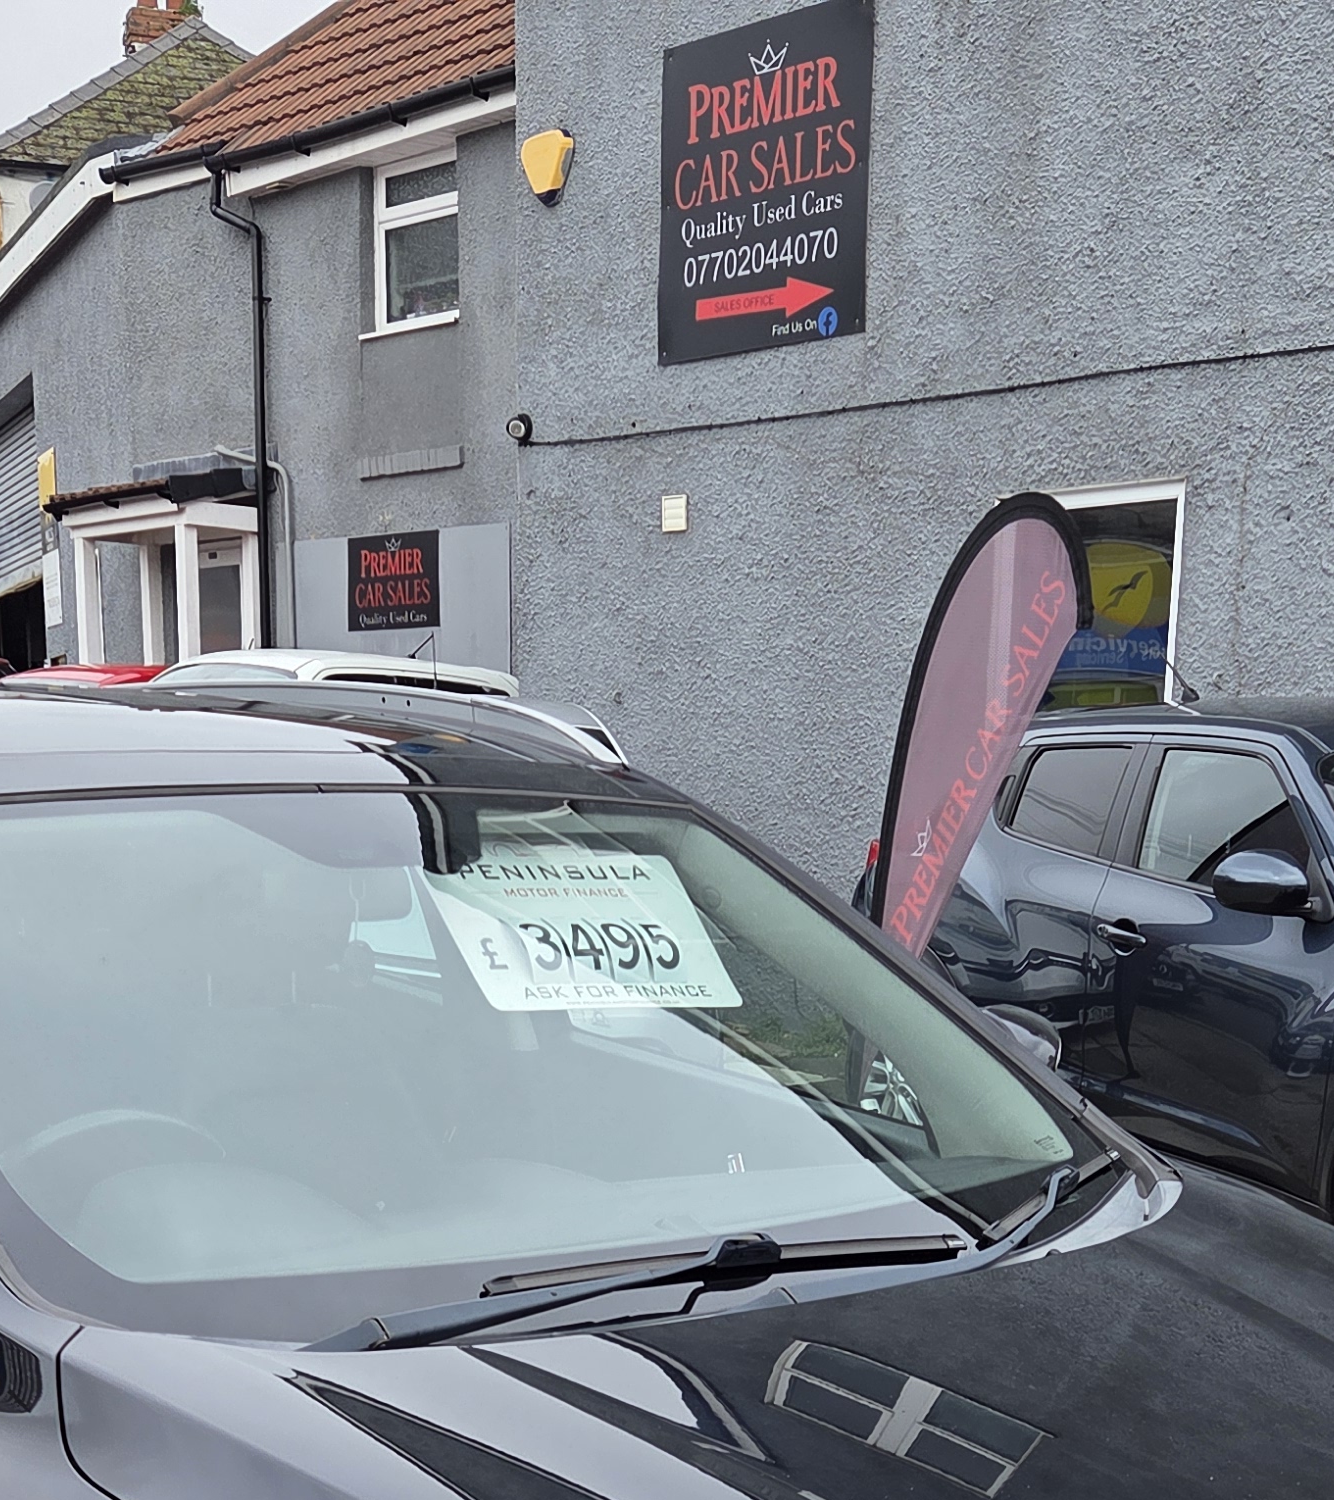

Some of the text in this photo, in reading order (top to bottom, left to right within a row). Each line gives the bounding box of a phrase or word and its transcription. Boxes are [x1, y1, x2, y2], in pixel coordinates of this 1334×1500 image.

[687, 56, 841, 144] PREMIER
[674, 119, 857, 210] CAR SALES
[681, 190, 843, 248] Quality Used Cars
[683, 227, 839, 288] 07702044070
[714, 294, 775, 313] SALES OFFICE
[771, 324, 789, 337] Find
[791, 321, 803, 333] Us
[804, 318, 817, 330] On
[360, 548, 423, 578] PREMIER
[355, 578, 431, 609] CAR SALES
[359, 610, 427, 628] Quality Used Cars
[890, 570, 1066, 945] PREMIER CAR SALES
[459, 863, 651, 881] PENINSULA
[504, 887, 628, 898] MOTOR FINANCE
[524, 983, 713, 999] ASK FOR FINANCE
